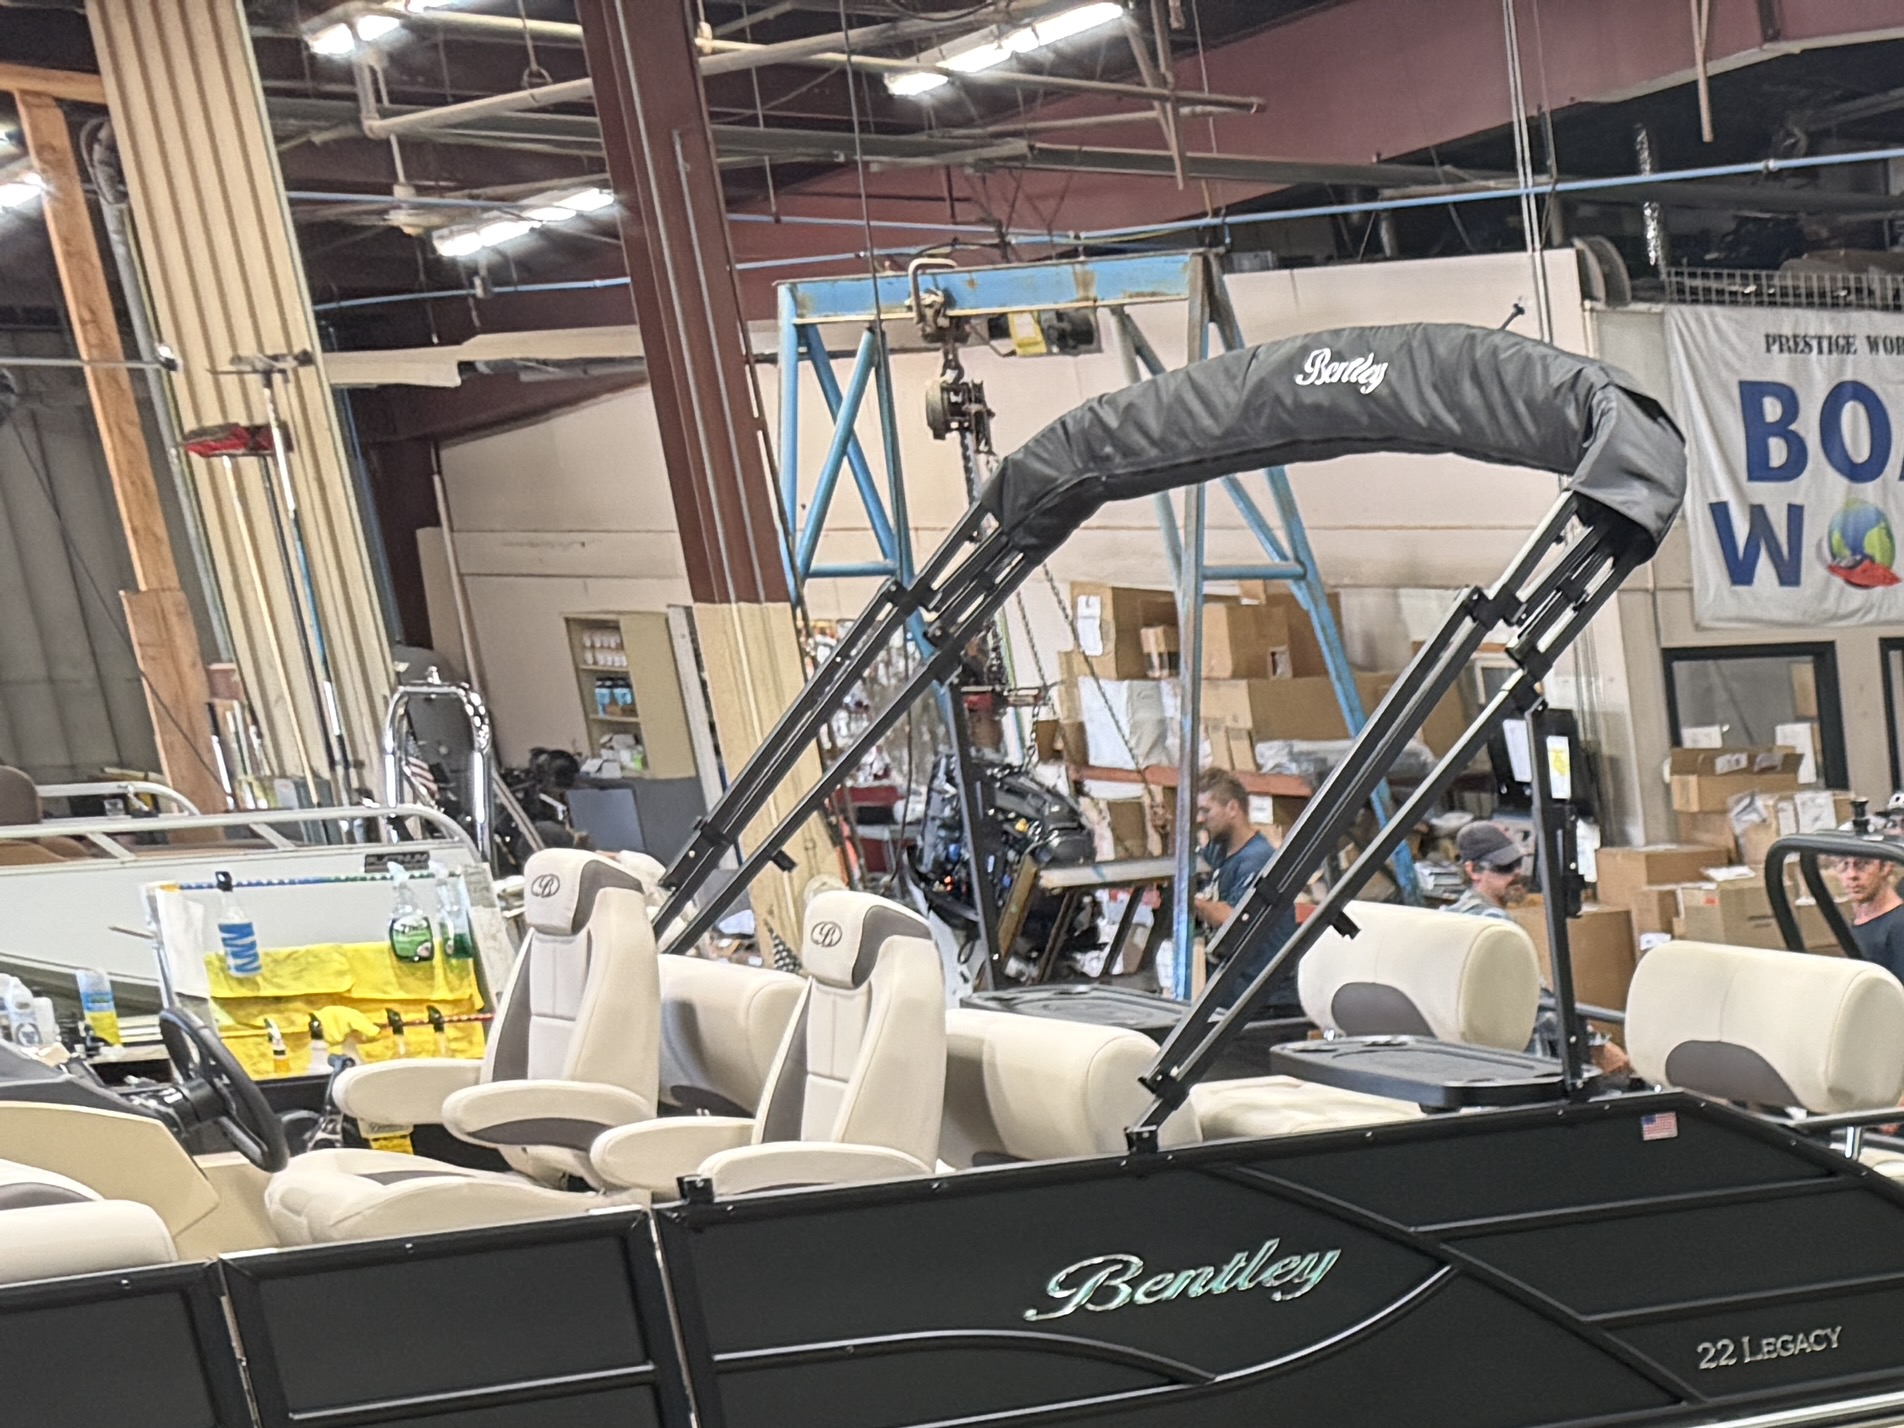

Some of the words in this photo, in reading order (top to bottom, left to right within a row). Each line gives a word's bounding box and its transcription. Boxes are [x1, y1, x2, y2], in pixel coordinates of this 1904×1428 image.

[1764, 333, 1857, 356] PRESTIGE
[1294, 347, 1389, 395] Bentley
[1023, 1237, 1342, 1322] Bentley
[1696, 1338, 1737, 1369] 22
[1741, 1325, 1842, 1363] LEGACY
